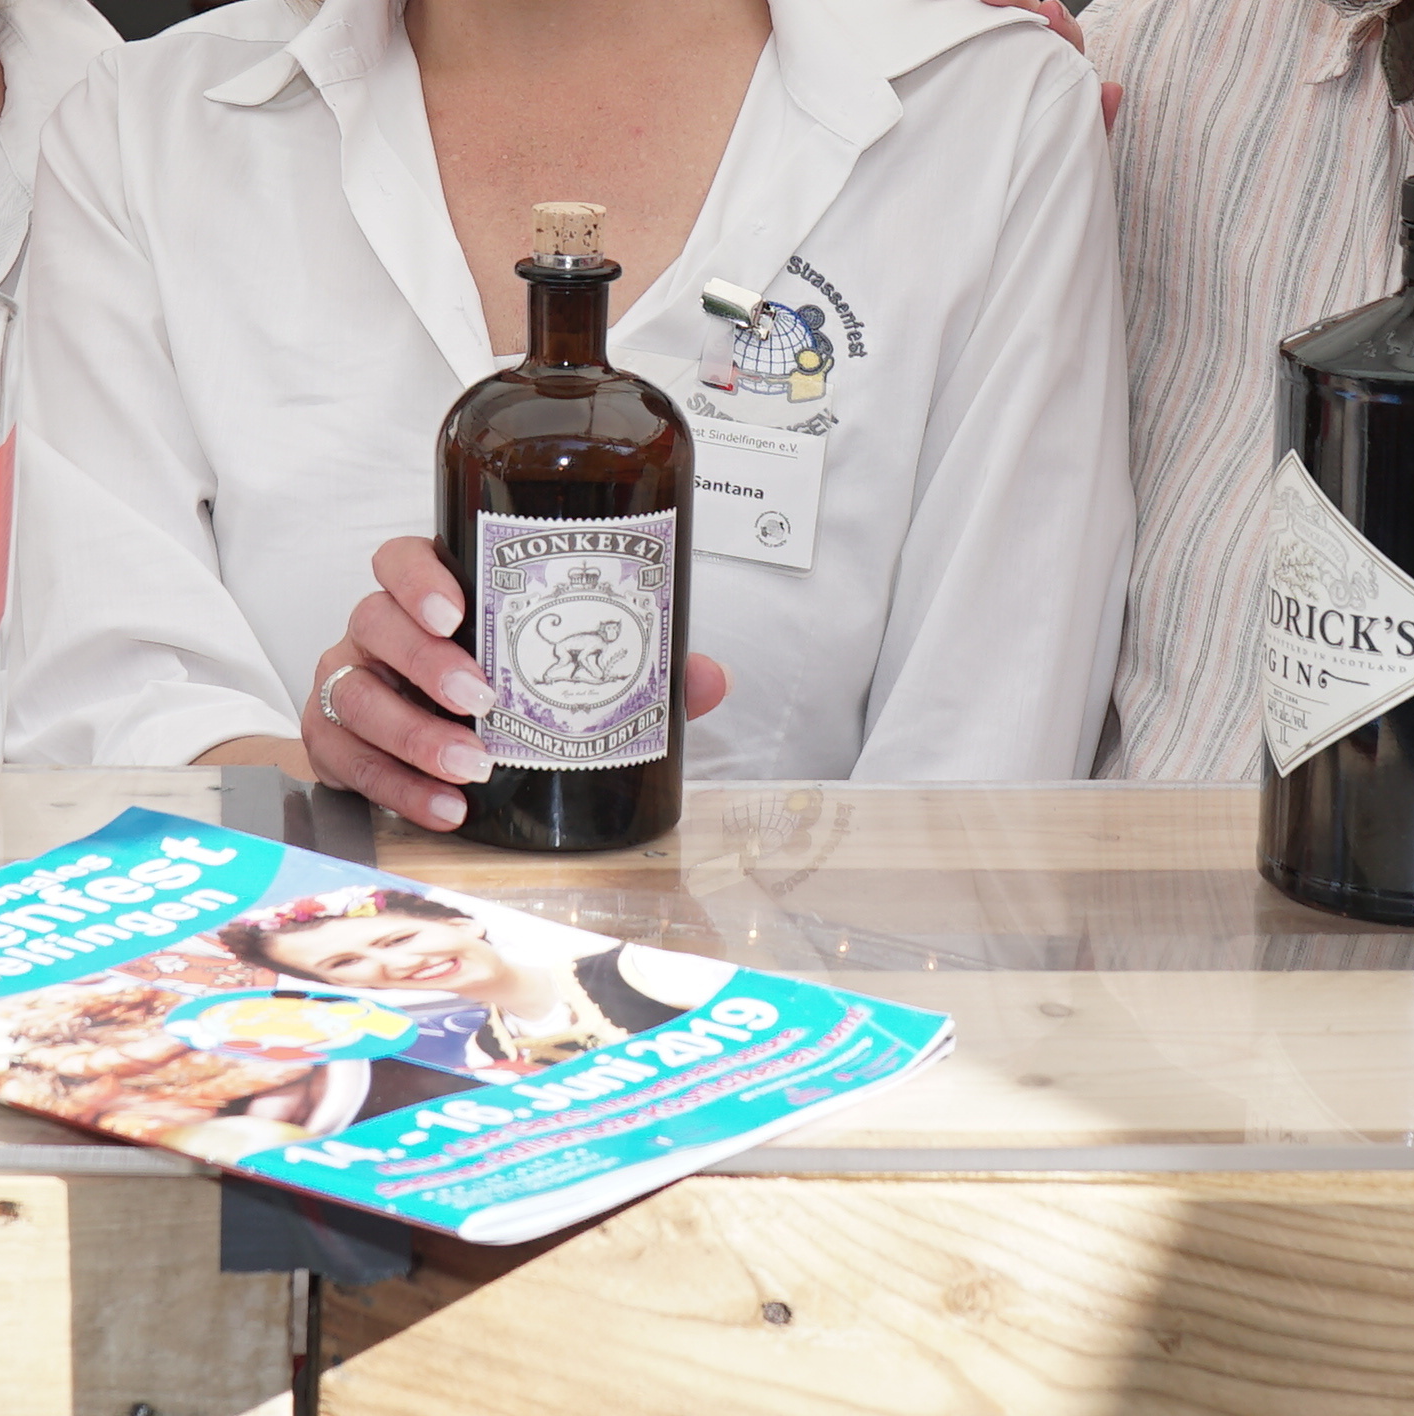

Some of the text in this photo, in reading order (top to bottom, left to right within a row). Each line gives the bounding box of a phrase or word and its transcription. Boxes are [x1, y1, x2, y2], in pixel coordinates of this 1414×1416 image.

[787, 255, 867, 359] Strassenfest
[708, 429, 776, 449] Sindelfingen
[779, 443, 799, 454] e.V.
[694, 474, 765, 500] Santana
[500, 533, 633, 564] MONKEY
[634, 536, 660, 560] 47
[485, 612, 494, 678] HANDCRAFTED
[1333, 656, 1407, 674] SCOTLAND
[1268, 646, 1312, 688] GIN
[492, 714, 658, 758] SCHWARZWALD DRY GIN
[511, 1053, 659, 1112] Juni
[625, 996, 780, 1068] 2019
